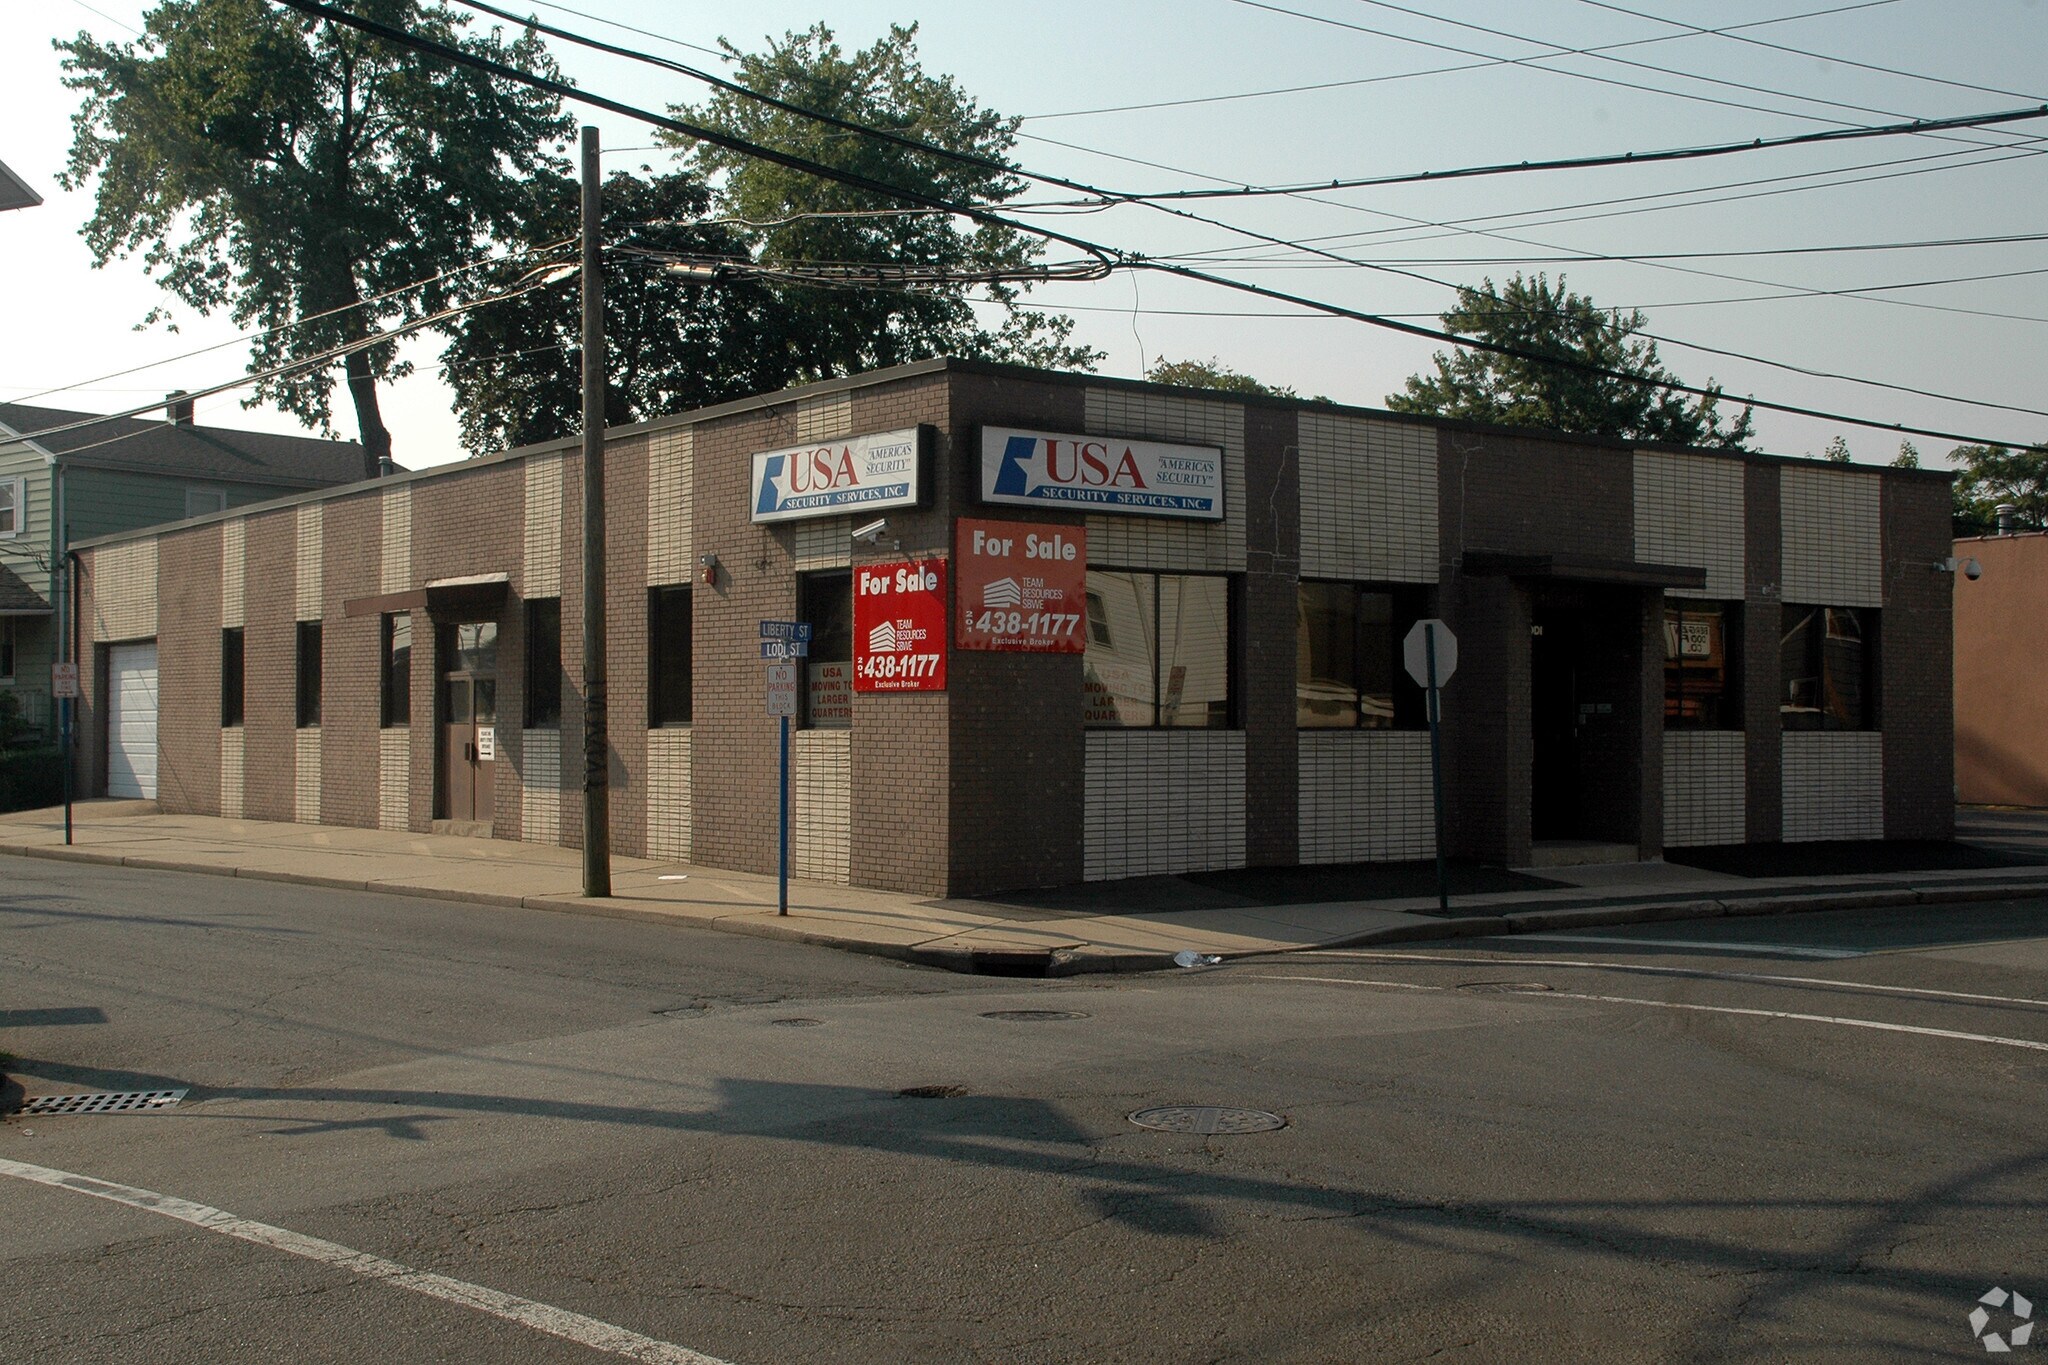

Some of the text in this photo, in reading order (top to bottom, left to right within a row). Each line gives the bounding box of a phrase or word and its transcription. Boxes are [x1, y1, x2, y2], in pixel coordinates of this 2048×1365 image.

[788, 446, 860, 493] USA
[1041, 439, 1149, 489] USA
[786, 486, 904, 509] SECURITY SERVICES, INC.
[1042, 488, 1109, 502] SECURITY
[1182, 499, 1206, 509] INC.
[974, 530, 1076, 560] For Sale
[860, 566, 937, 595] For Sale
[1022, 578, 1044, 587] TEAM
[1022, 589, 1063, 600] RESOURCES
[896, 620, 912, 629] TEAM
[976, 611, 1080, 635] 438-1177
[763, 624, 808, 637] LIBERTY ST
[896, 629, 926, 640] RESOURCES
[992, 637, 1054, 646] Exclusive Broker
[767, 643, 800, 656] LODI ST
[864, 654, 940, 678] 438-1177
[775, 671, 787, 680] NO
[822, 668, 842, 678] USA
[769, 682, 794, 692] PARKING
[812, 682, 840, 691] MOVING
[818, 694, 848, 705] LARGER
[1093, 696, 1138, 707] LARGER
[1085, 710, 1146, 721] QUARTERS
